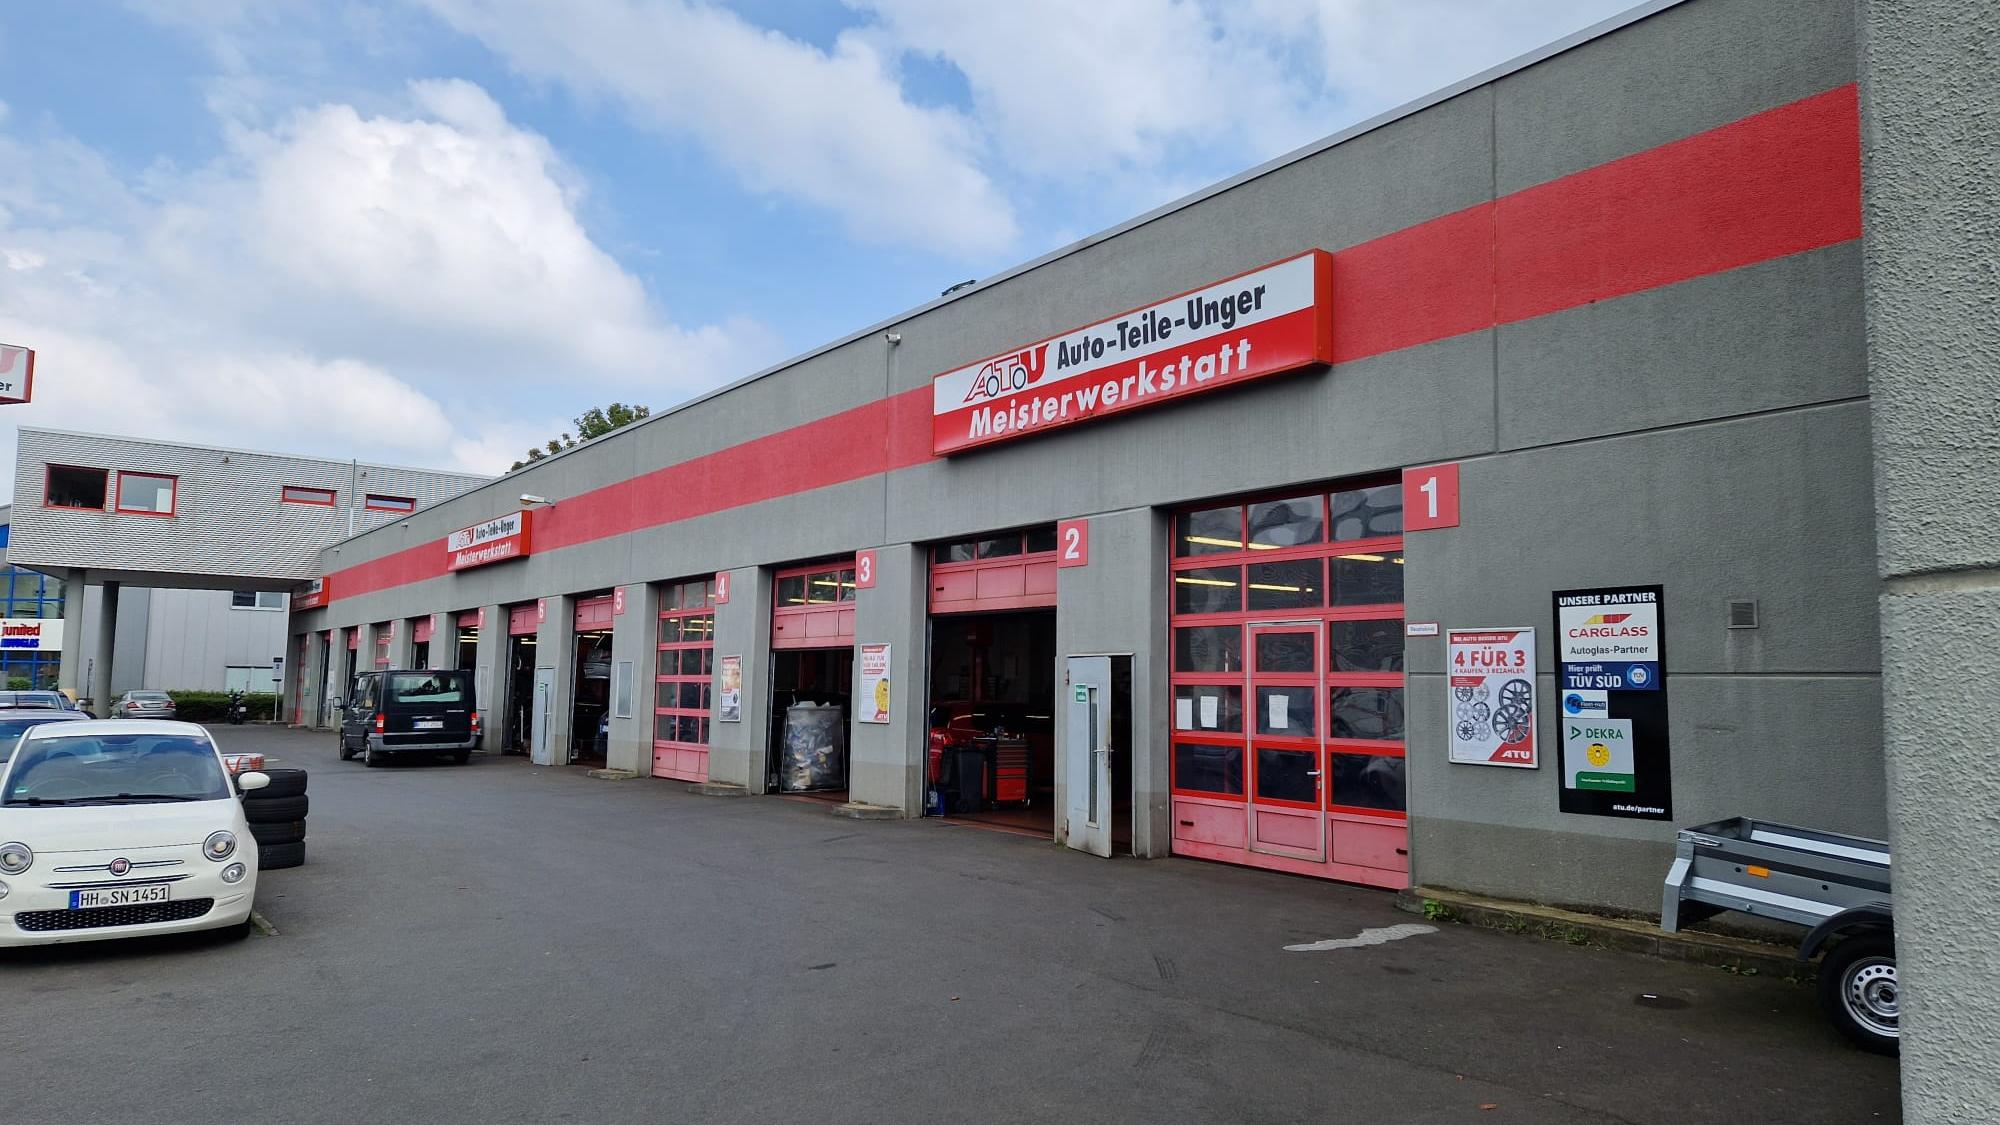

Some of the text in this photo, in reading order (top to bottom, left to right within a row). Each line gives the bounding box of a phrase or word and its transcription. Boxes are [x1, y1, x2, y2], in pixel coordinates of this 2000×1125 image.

[964, 283, 1266, 403] ATU Auto-Teile-Unger
[968, 338, 1252, 439] Meisterwerkstatt
[1420, 477, 1438, 518] 1
[1064, 527, 1080, 560] 2
[456, 540, 511, 566] Meisterwerkstatt
[860, 556, 870, 582] 3
[718, 577, 726, 598] 4
[616, 592, 622, 610] 5
[1559, 592, 1656, 606] UNSERE PARTNER
[538, 602, 544, 618] 6
[1569, 626, 1649, 638] CARGLASS
[1455, 646, 1525, 667] 4 FÜR 3
[1570, 645, 1649, 656] Autoglas-Partner
[1568, 664, 1603, 673] Hier prüft
[1568, 673, 1622, 688] TÜV SÜD
[1586, 728, 1624, 739] DEKRA
[1501, 750, 1531, 759] ATU
[1613, 804, 1665, 814] atu.de/partner
[80, 887, 166, 907] HH SN 1451
